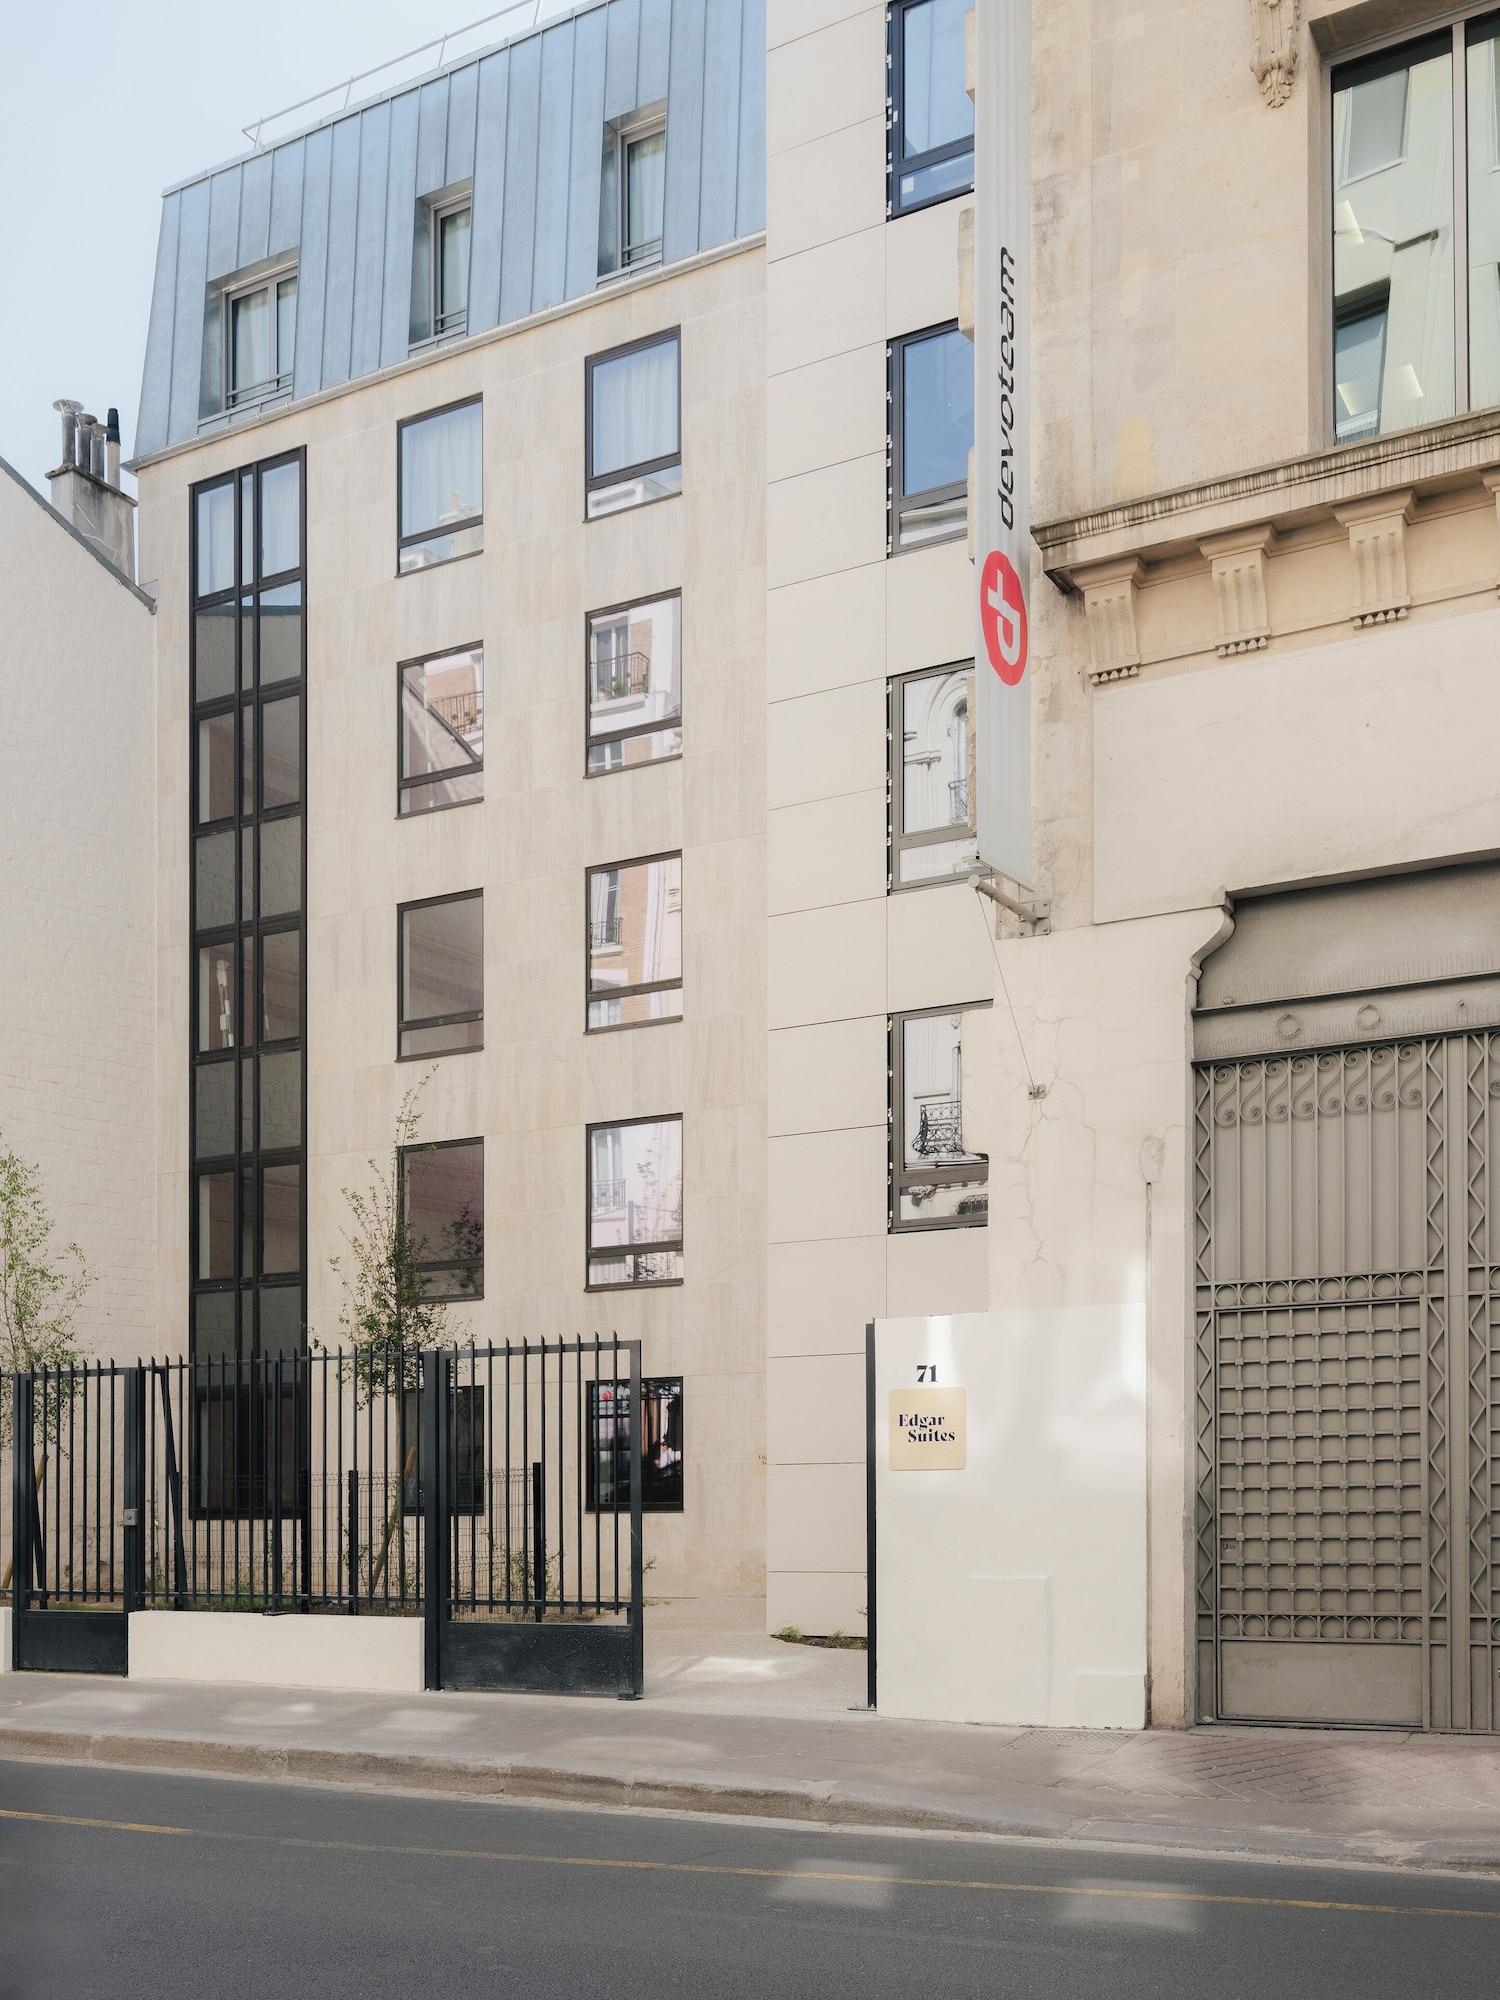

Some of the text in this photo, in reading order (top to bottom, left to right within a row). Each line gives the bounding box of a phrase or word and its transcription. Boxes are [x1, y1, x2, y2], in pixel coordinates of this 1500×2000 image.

[997, 246, 1015, 531] devoteam
[916, 1364, 938, 1383] 71
[898, 1413, 945, 1430] Edgar
[908, 1428, 956, 1443] Suites
